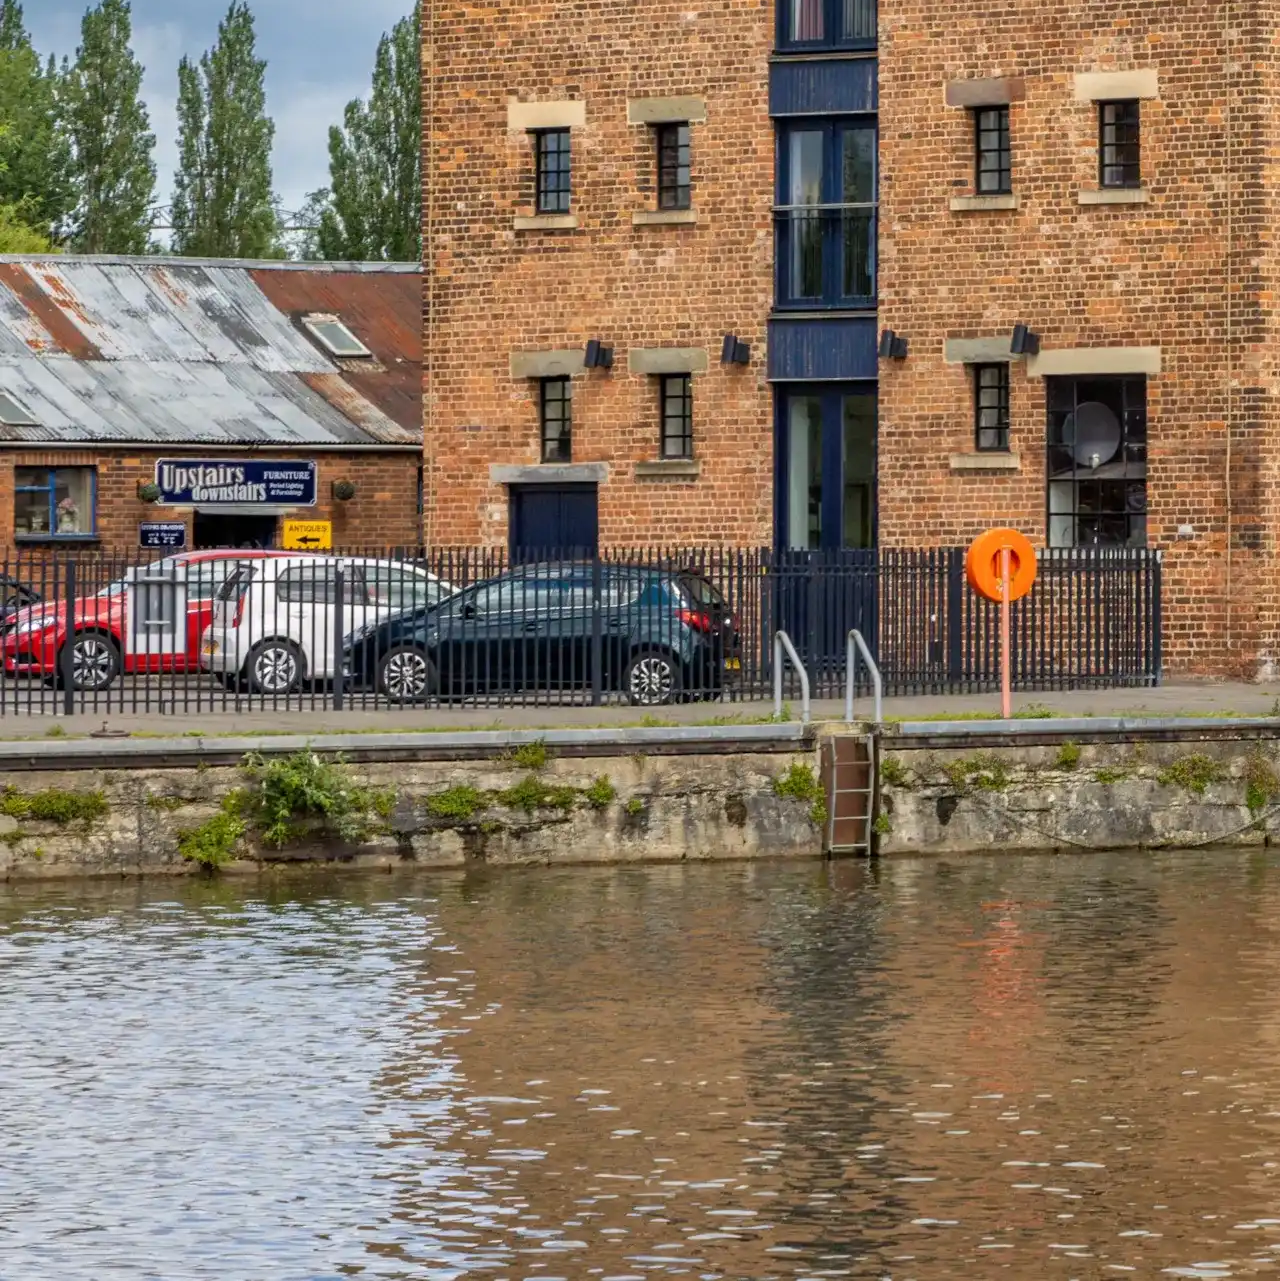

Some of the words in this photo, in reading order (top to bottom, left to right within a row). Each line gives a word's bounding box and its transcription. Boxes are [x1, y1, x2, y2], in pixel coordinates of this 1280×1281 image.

[162, 464, 244, 494] Upstairs
[263, 471, 311, 480] FURNITURE
[191, 482, 268, 501] downstairs
[288, 524, 327, 532] ANTIQUES
